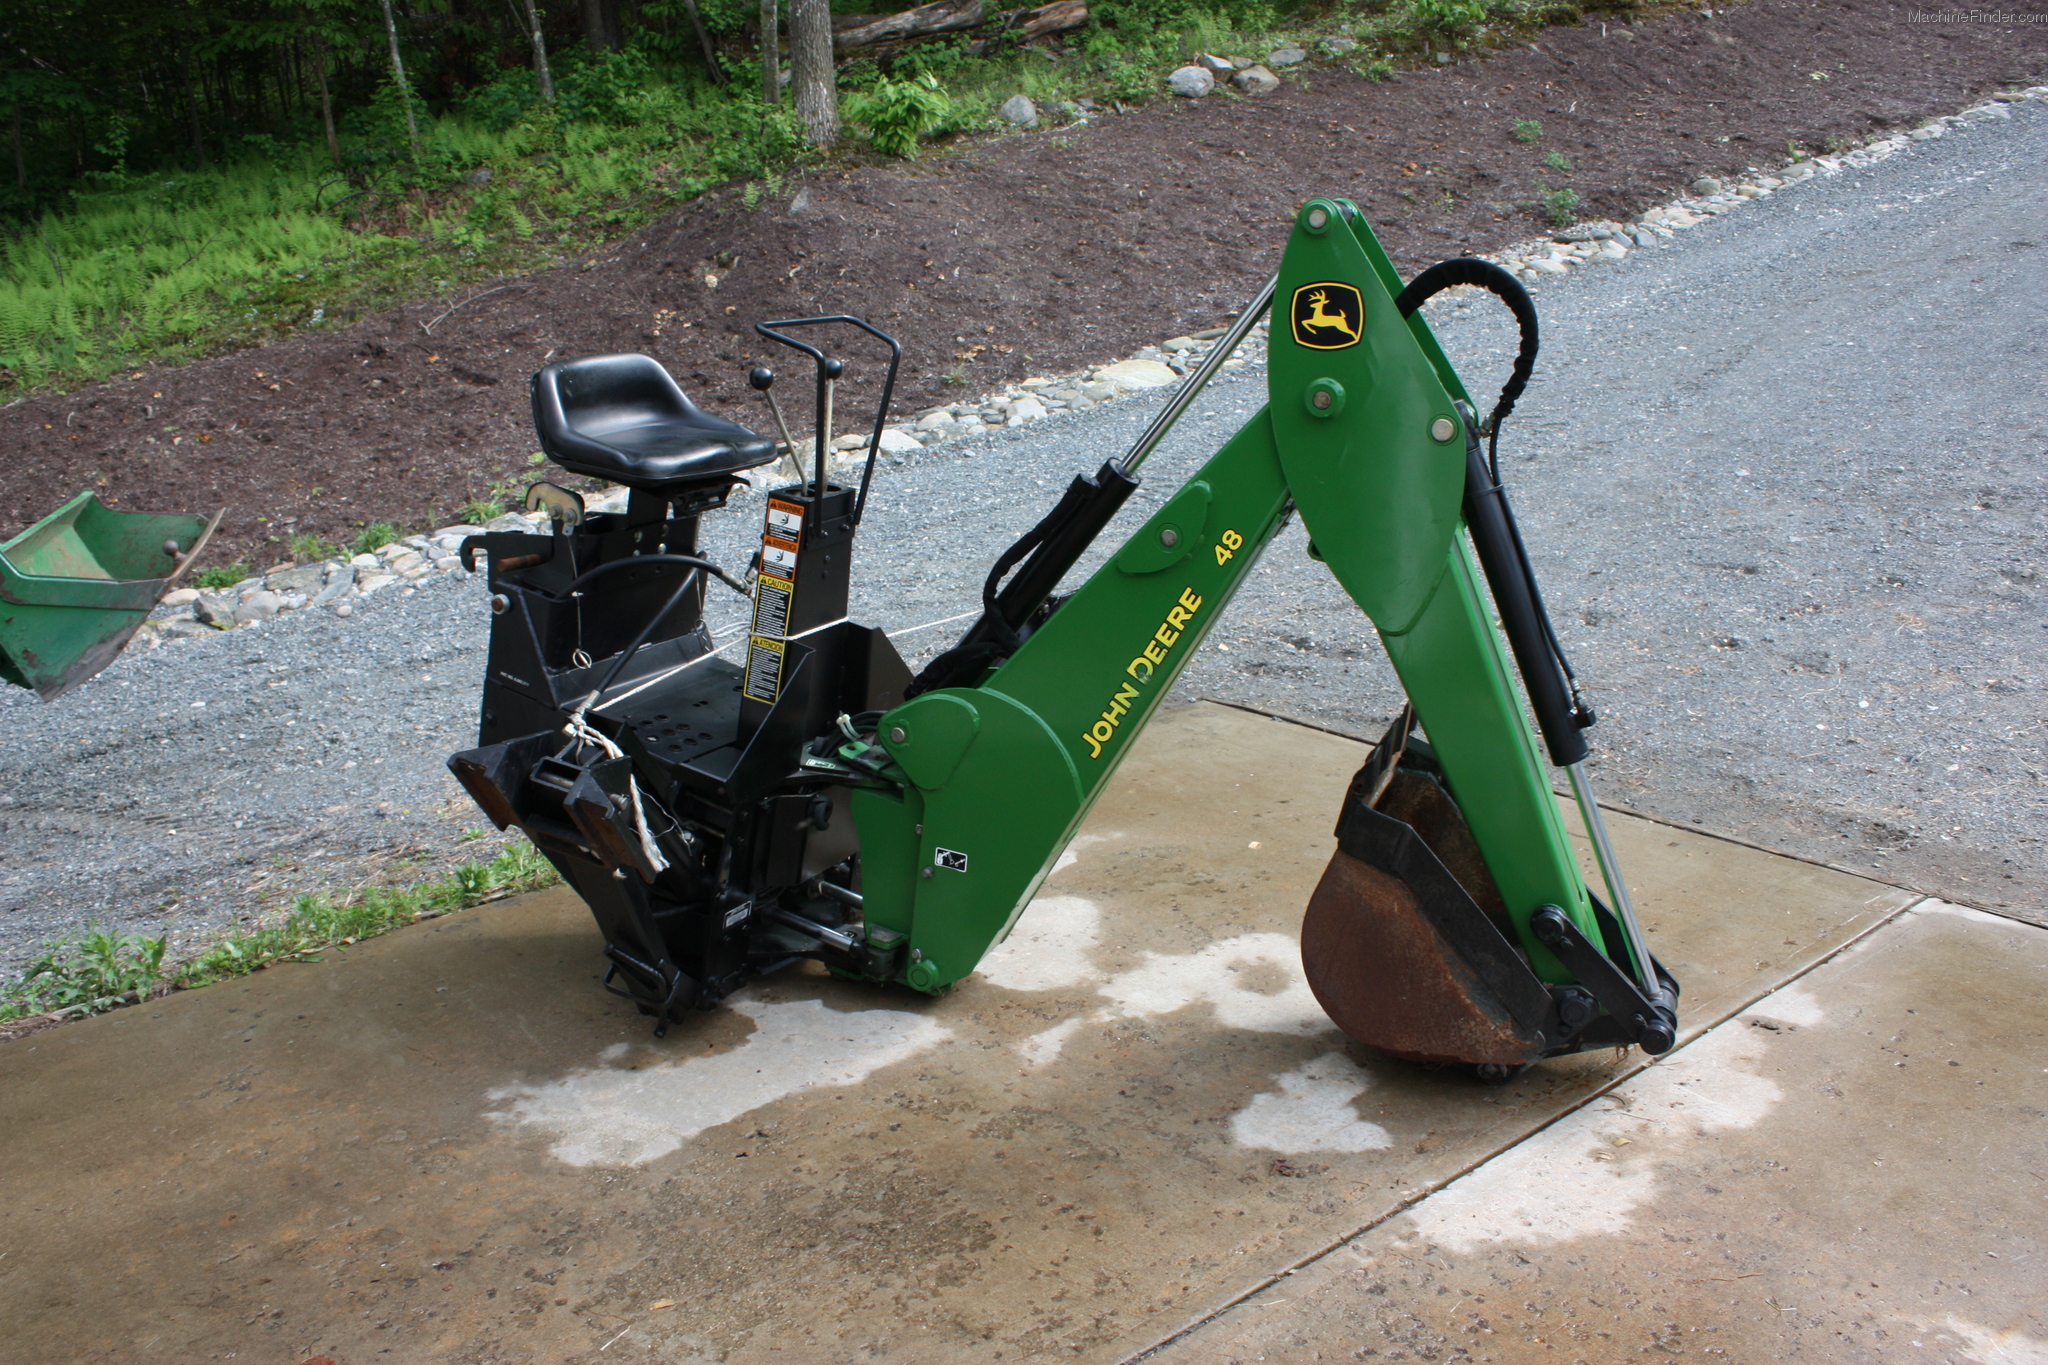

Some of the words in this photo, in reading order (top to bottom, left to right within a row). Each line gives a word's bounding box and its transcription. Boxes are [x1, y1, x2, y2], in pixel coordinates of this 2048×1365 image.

[1213, 528, 1243, 566] 48
[1081, 681, 1140, 760] JOHN
[1126, 586, 1203, 686] DEERE
